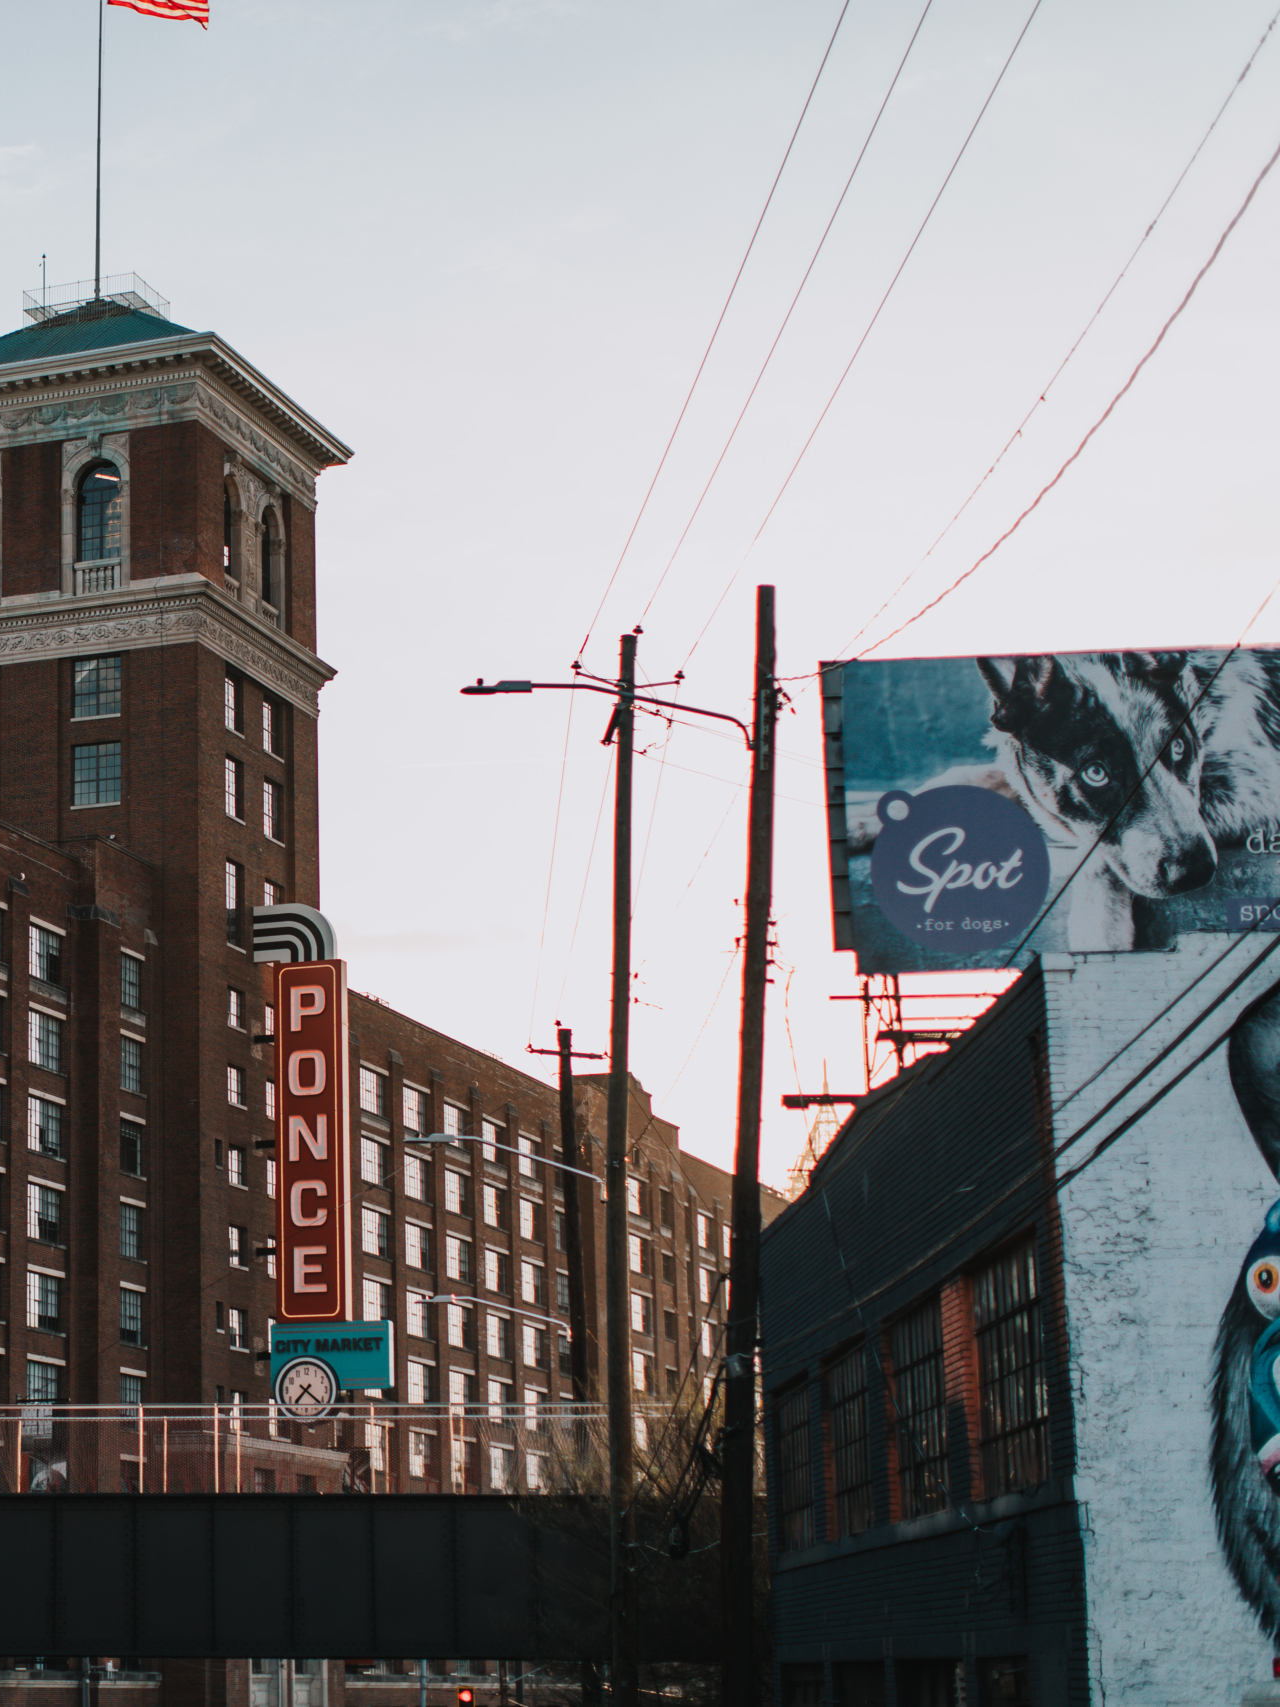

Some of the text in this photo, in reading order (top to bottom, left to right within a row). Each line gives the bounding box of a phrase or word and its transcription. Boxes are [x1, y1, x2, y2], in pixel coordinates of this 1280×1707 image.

[896, 826, 1023, 913] Spot
[924, 917, 1002, 933] for dogs
[288, 984, 328, 1294] PONCE
[275, 1336, 383, 1353] CITY MARKET
[295, 1370, 301, 1378] 11
[303, 1367, 310, 1376] 12
[288, 1377, 294, 1385] 10
[320, 1376, 324, 1384] 2
[285, 1386, 289, 1394] 9
[324, 1385, 328, 1394] 3
